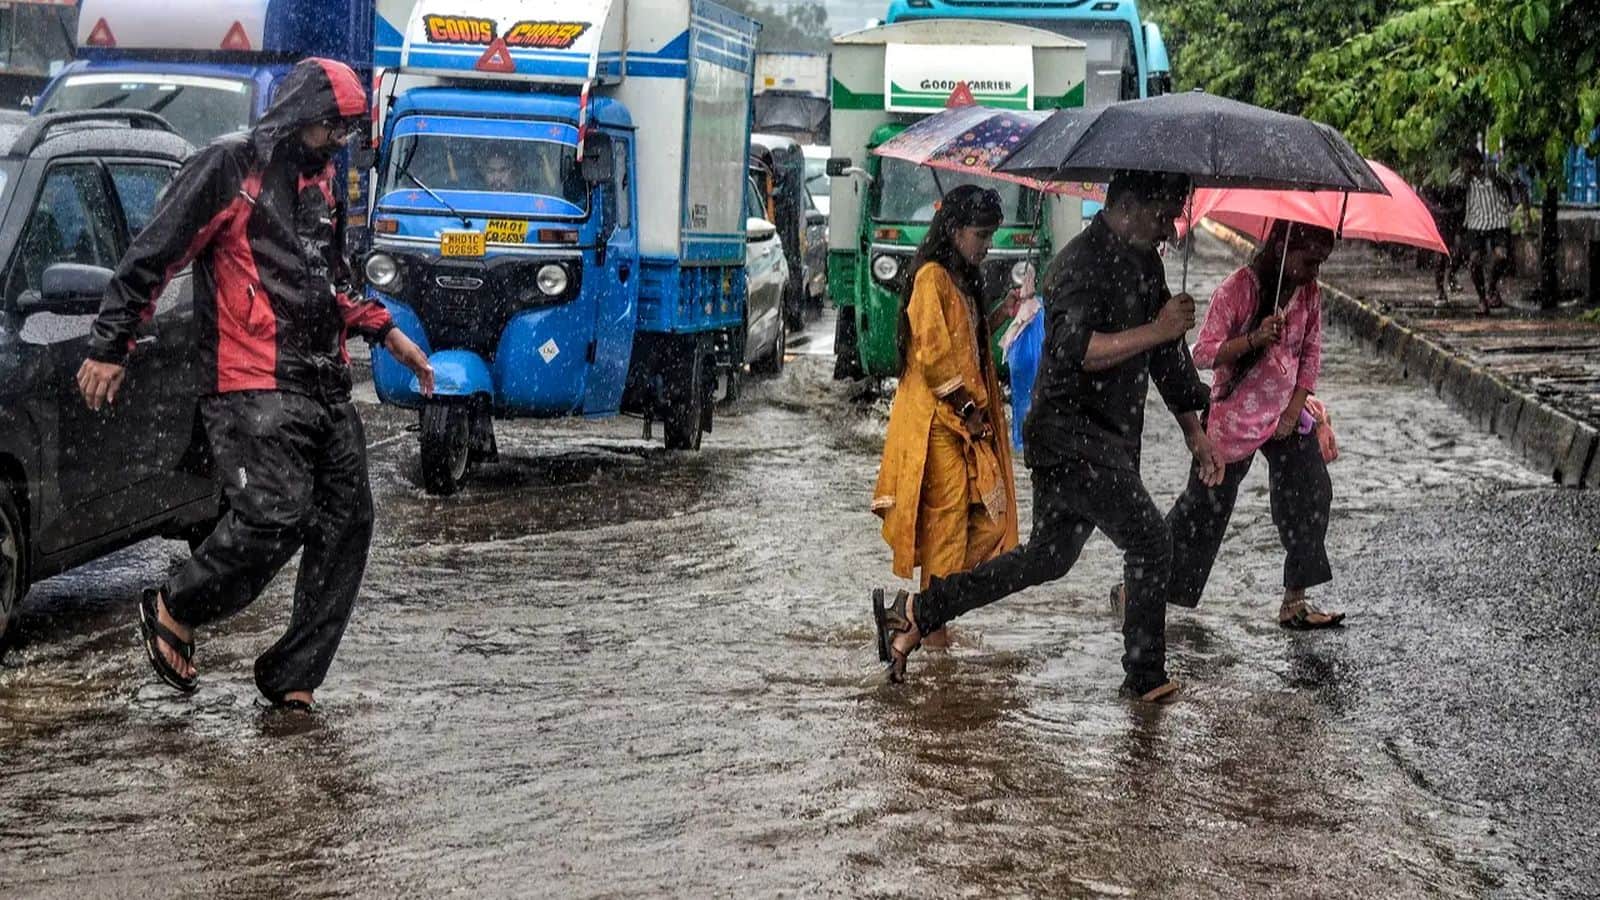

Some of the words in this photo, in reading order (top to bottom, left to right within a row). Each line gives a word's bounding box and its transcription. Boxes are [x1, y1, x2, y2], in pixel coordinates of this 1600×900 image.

[427, 15, 494, 43] GOODS
[504, 21, 585, 47] CARRIER
[920, 79, 961, 90] GOOD
[967, 80, 1011, 91] CARRIER
